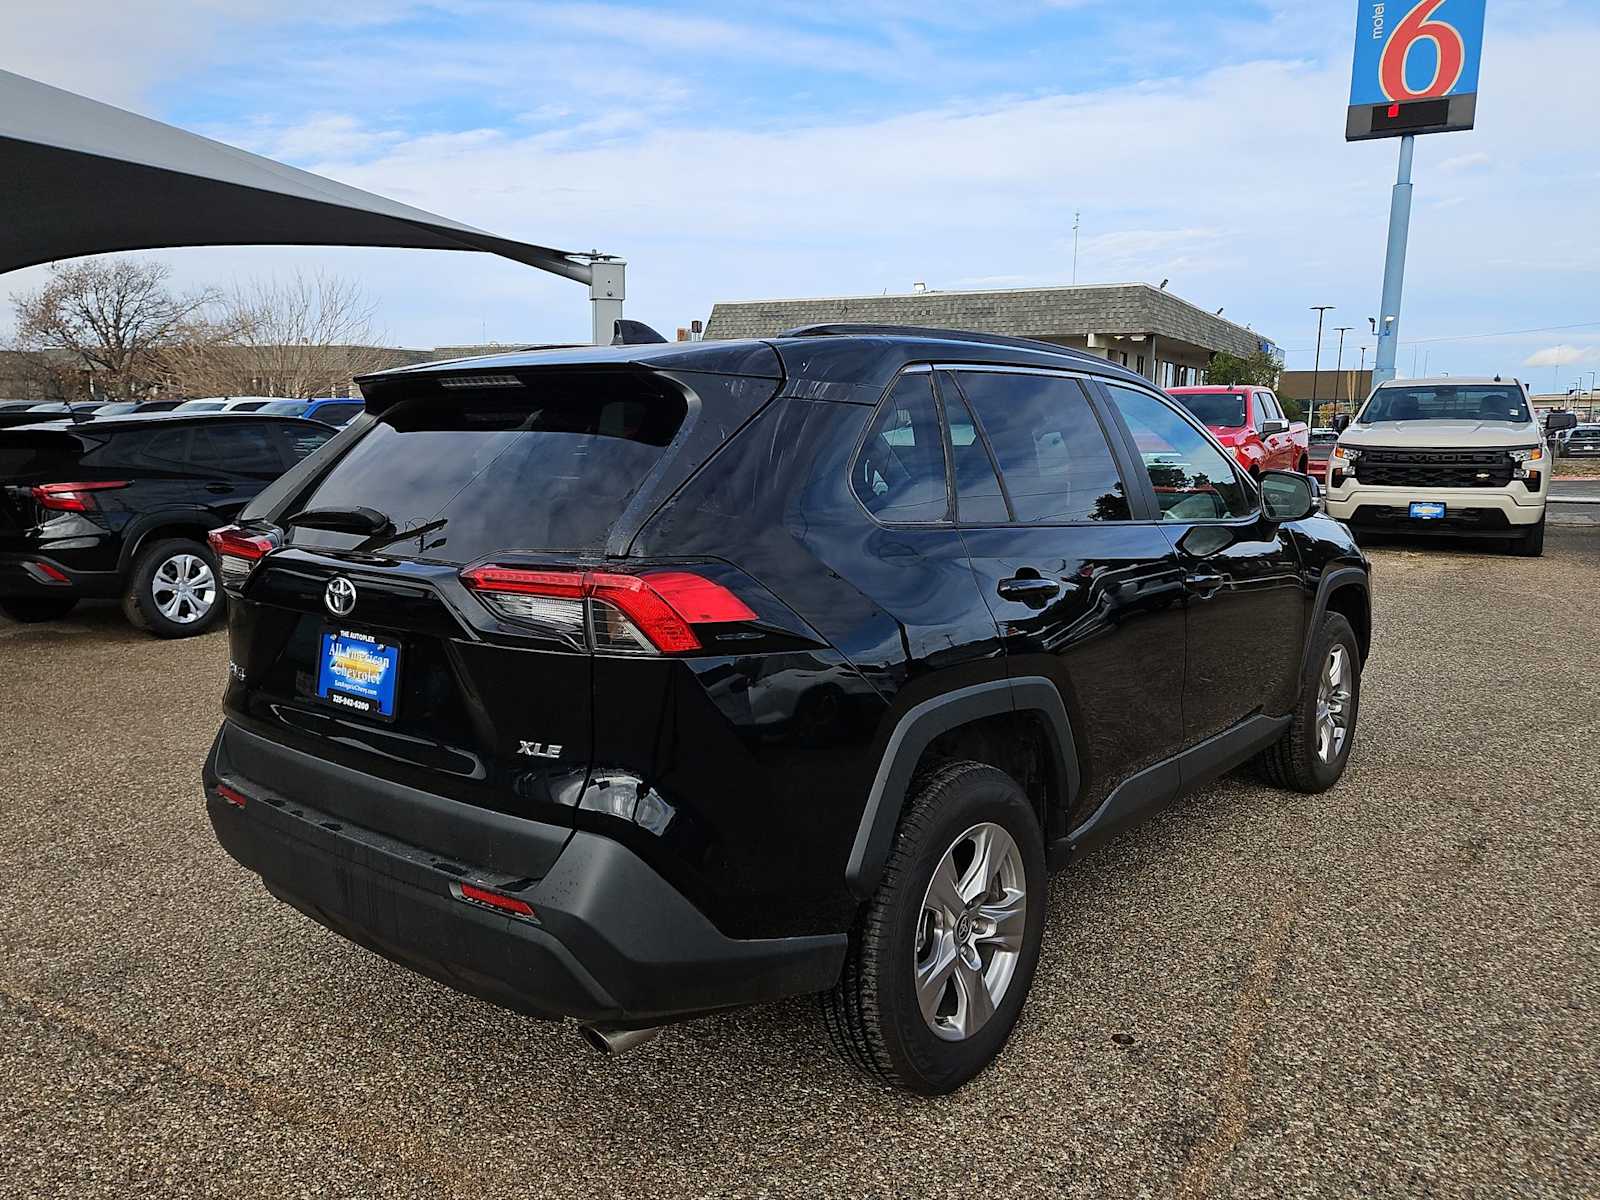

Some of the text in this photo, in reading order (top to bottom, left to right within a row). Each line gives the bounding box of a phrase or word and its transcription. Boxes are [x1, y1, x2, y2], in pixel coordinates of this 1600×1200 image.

[1372, 0, 1465, 101] motel 6
[350, 632, 375, 643] AUTOPLEX
[329, 642, 389, 668] All American
[335, 662, 380, 684] Chevrolet
[516, 740, 563, 758] XLE
